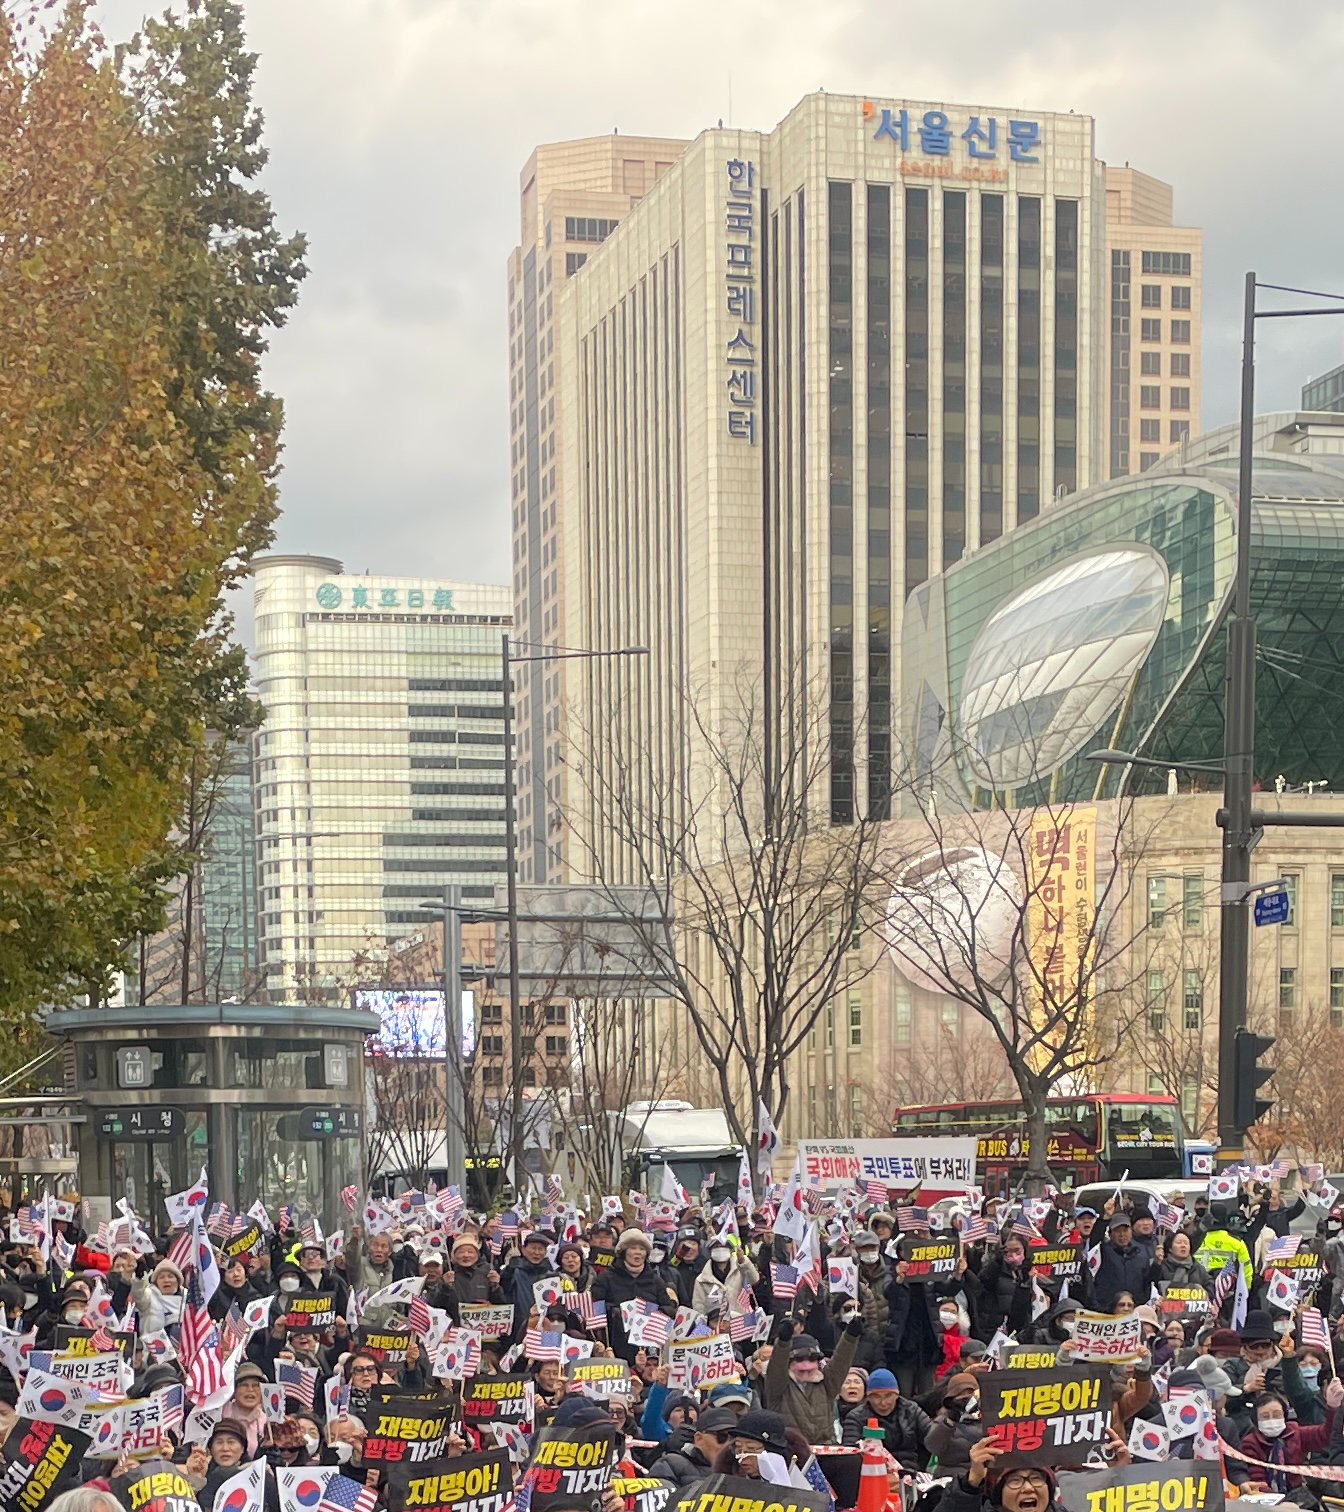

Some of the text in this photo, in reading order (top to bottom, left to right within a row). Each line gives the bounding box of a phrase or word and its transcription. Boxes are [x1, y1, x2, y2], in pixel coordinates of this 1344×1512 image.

[873, 109, 1042, 164] 서울신문
[725, 157, 755, 446] 한국프레스센터
[987, 1139, 1008, 1157] BUS
[806, 1156, 971, 1181] 국회해산 국민투표에 부쳐라!
[910, 1244, 956, 1261] 재명아!
[1032, 1248, 1076, 1264] 재명아!
[1052, 1261, 1082, 1276] 가자!
[291, 1297, 331, 1314] 재명아!
[493, 1309, 511, 1321] 조국
[309, 1310, 336, 1326] 가자!
[1075, 1318, 1139, 1337] 문재인 조국
[712, 1341, 732, 1357] 조국
[1074, 1335, 1139, 1357] 구속하라
[91, 1361, 119, 1374] 조국
[573, 1365, 624, 1381] 재명아!
[671, 1359, 736, 1384] 구하라
[471, 1380, 525, 1399] 재명아!
[998, 1378, 1102, 1419] 재명아!
[375, 1415, 446, 1440] 재명아!
[1046, 1410, 1113, 1446] 가자!
[364, 1435, 448, 1462] 깜방 가자!
[532, 1440, 609, 1468] 재명아!
[406, 1462, 501, 1507] 재명아!
[562, 1465, 612, 1495] 가자!
